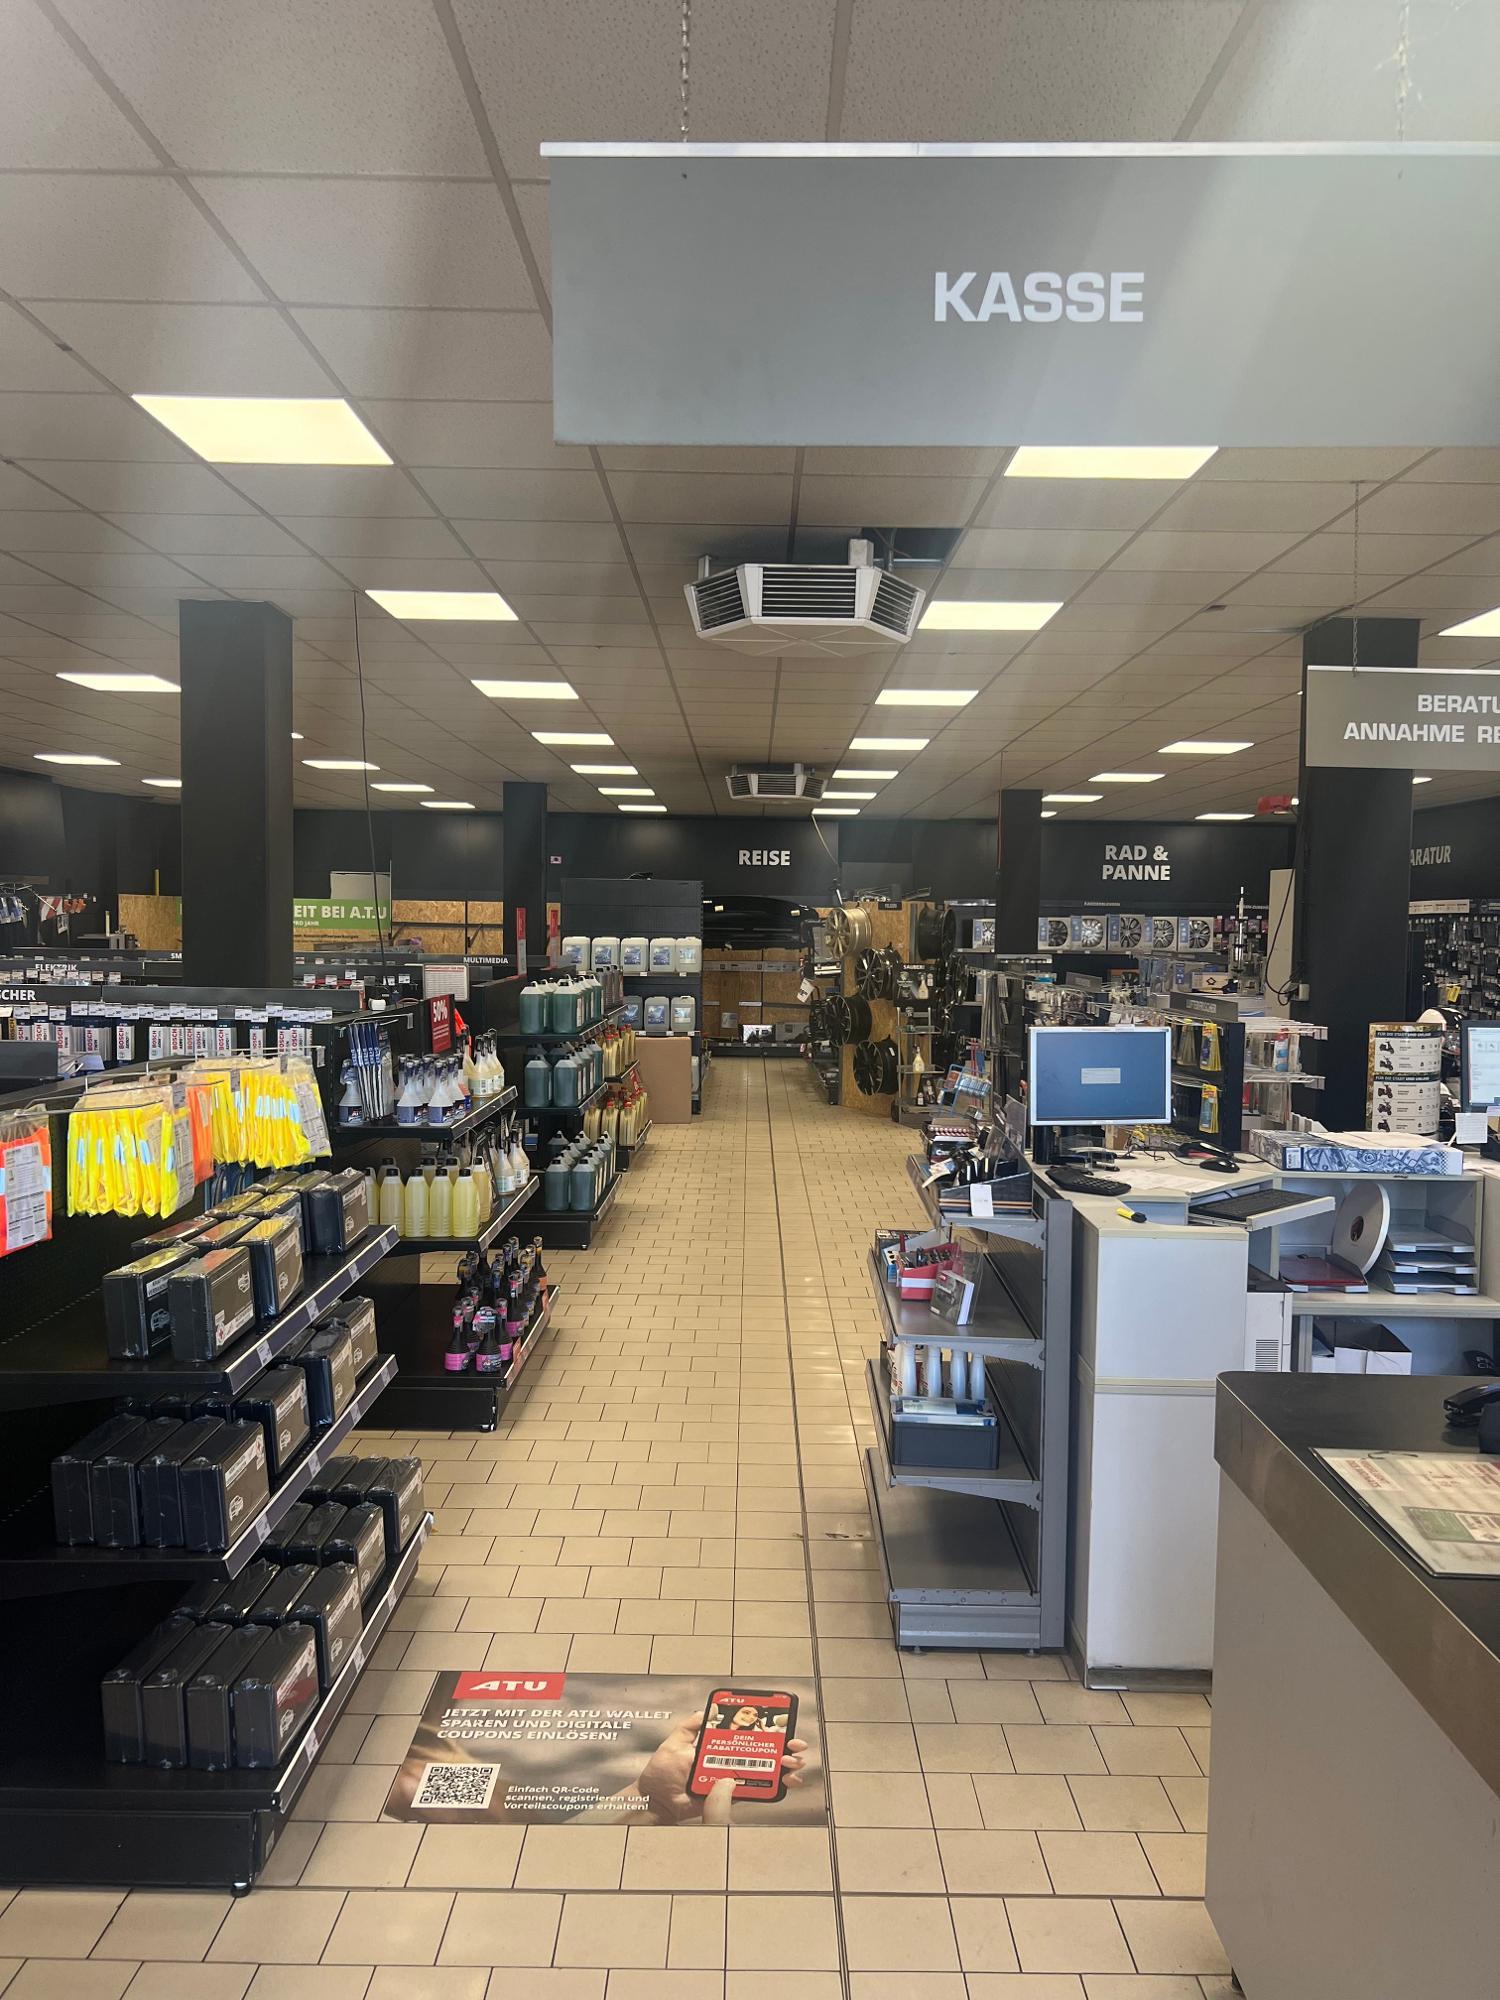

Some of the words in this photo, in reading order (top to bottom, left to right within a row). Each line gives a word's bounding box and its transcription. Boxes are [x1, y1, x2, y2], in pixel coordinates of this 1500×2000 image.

[934, 271, 1145, 323] KASSE
[1343, 722, 1465, 743] ANNAHME
[738, 849, 791, 866] REISE
[1105, 844, 1148, 861] RAD
[1153, 845, 1169, 861] &
[1102, 864, 1171, 881] PANNE
[321, 905, 345, 918] BEI
[350, 906, 387, 920] A.T.U
[463, 956, 509, 964] MULTIMEDIA
[469, 1680, 548, 1692] ATU
[441, 1708, 491, 1718] JETZT
[494, 1709, 527, 1717] MIT
[530, 1709, 563, 1718] DER
[567, 1709, 601, 1718] ATU
[605, 1710, 672, 1719] WALLET
[440, 1719, 508, 1728] SPAREN
[512, 1720, 552, 1728] UND
[556, 1720, 632, 1729] DIGITALE
[437, 1730, 522, 1739] COUPONS
[526, 1730, 618, 1740] EINLÖSEN!
[711, 1738, 776, 1748] PERSÖNLICHER
[706, 1744, 778, 1754] RABATTCOUPON
[508, 1785, 549, 1793] Einfach
[552, 1786, 600, 1794] QR-Code
[559, 1795, 625, 1803] registrieren
[503, 1802, 594, 1811] Vorteilscoupons
